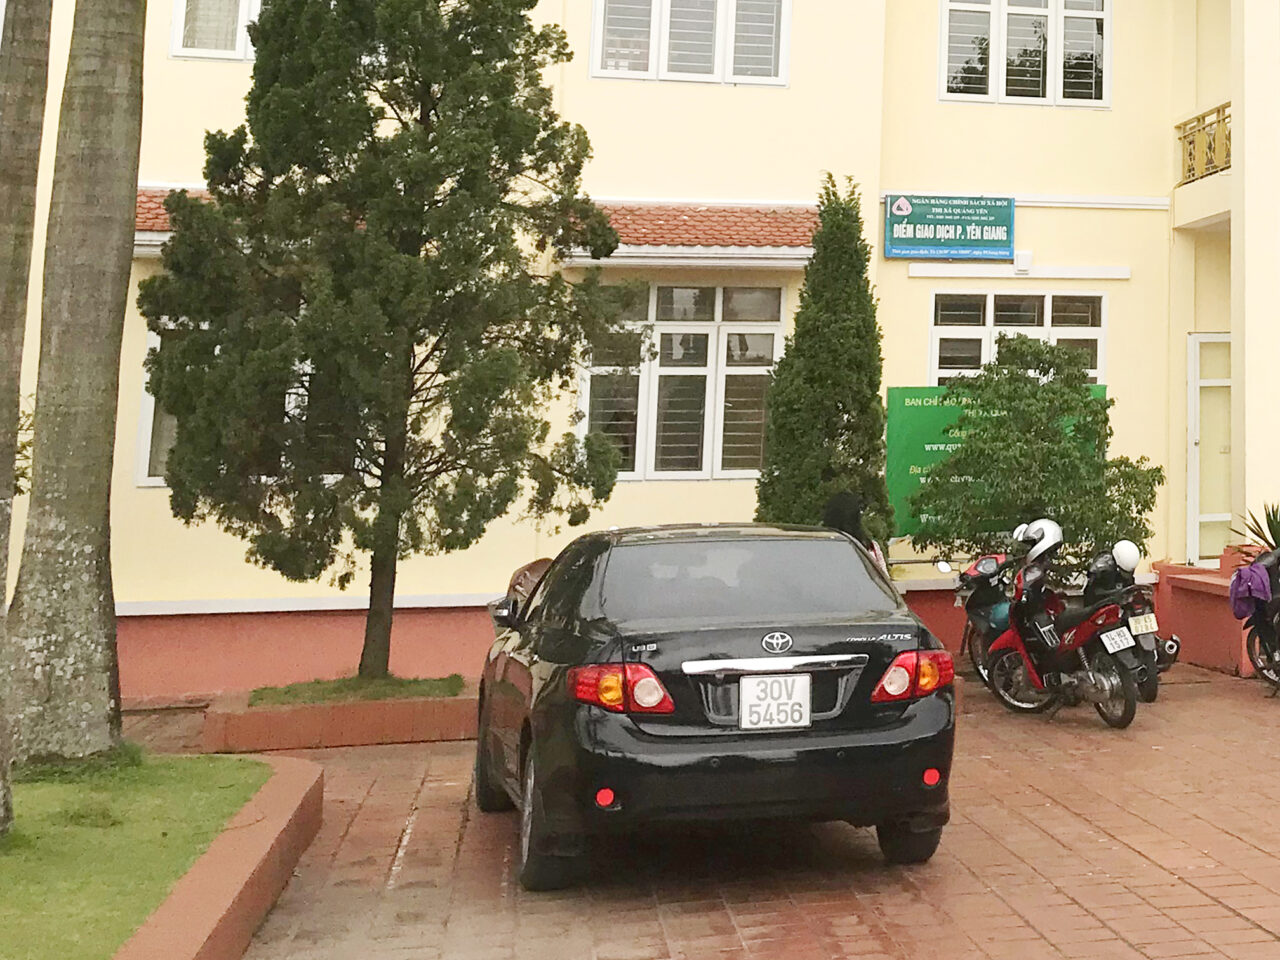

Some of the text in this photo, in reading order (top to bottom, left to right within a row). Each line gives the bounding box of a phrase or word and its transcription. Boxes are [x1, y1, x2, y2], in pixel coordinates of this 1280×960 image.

[893, 218, 914, 239] ĐIỂM
[915, 224, 935, 239] GIAO
[936, 224, 955, 242] DỊCH
[966, 222, 981, 240] YÊN
[983, 226, 1008, 240] GIANG
[904, 398, 921, 406] BAN
[923, 396, 938, 406] CHỈ
[876, 633, 912, 641] ALTIS
[756, 679, 797, 701] 30V
[749, 702, 803, 726] 5456
